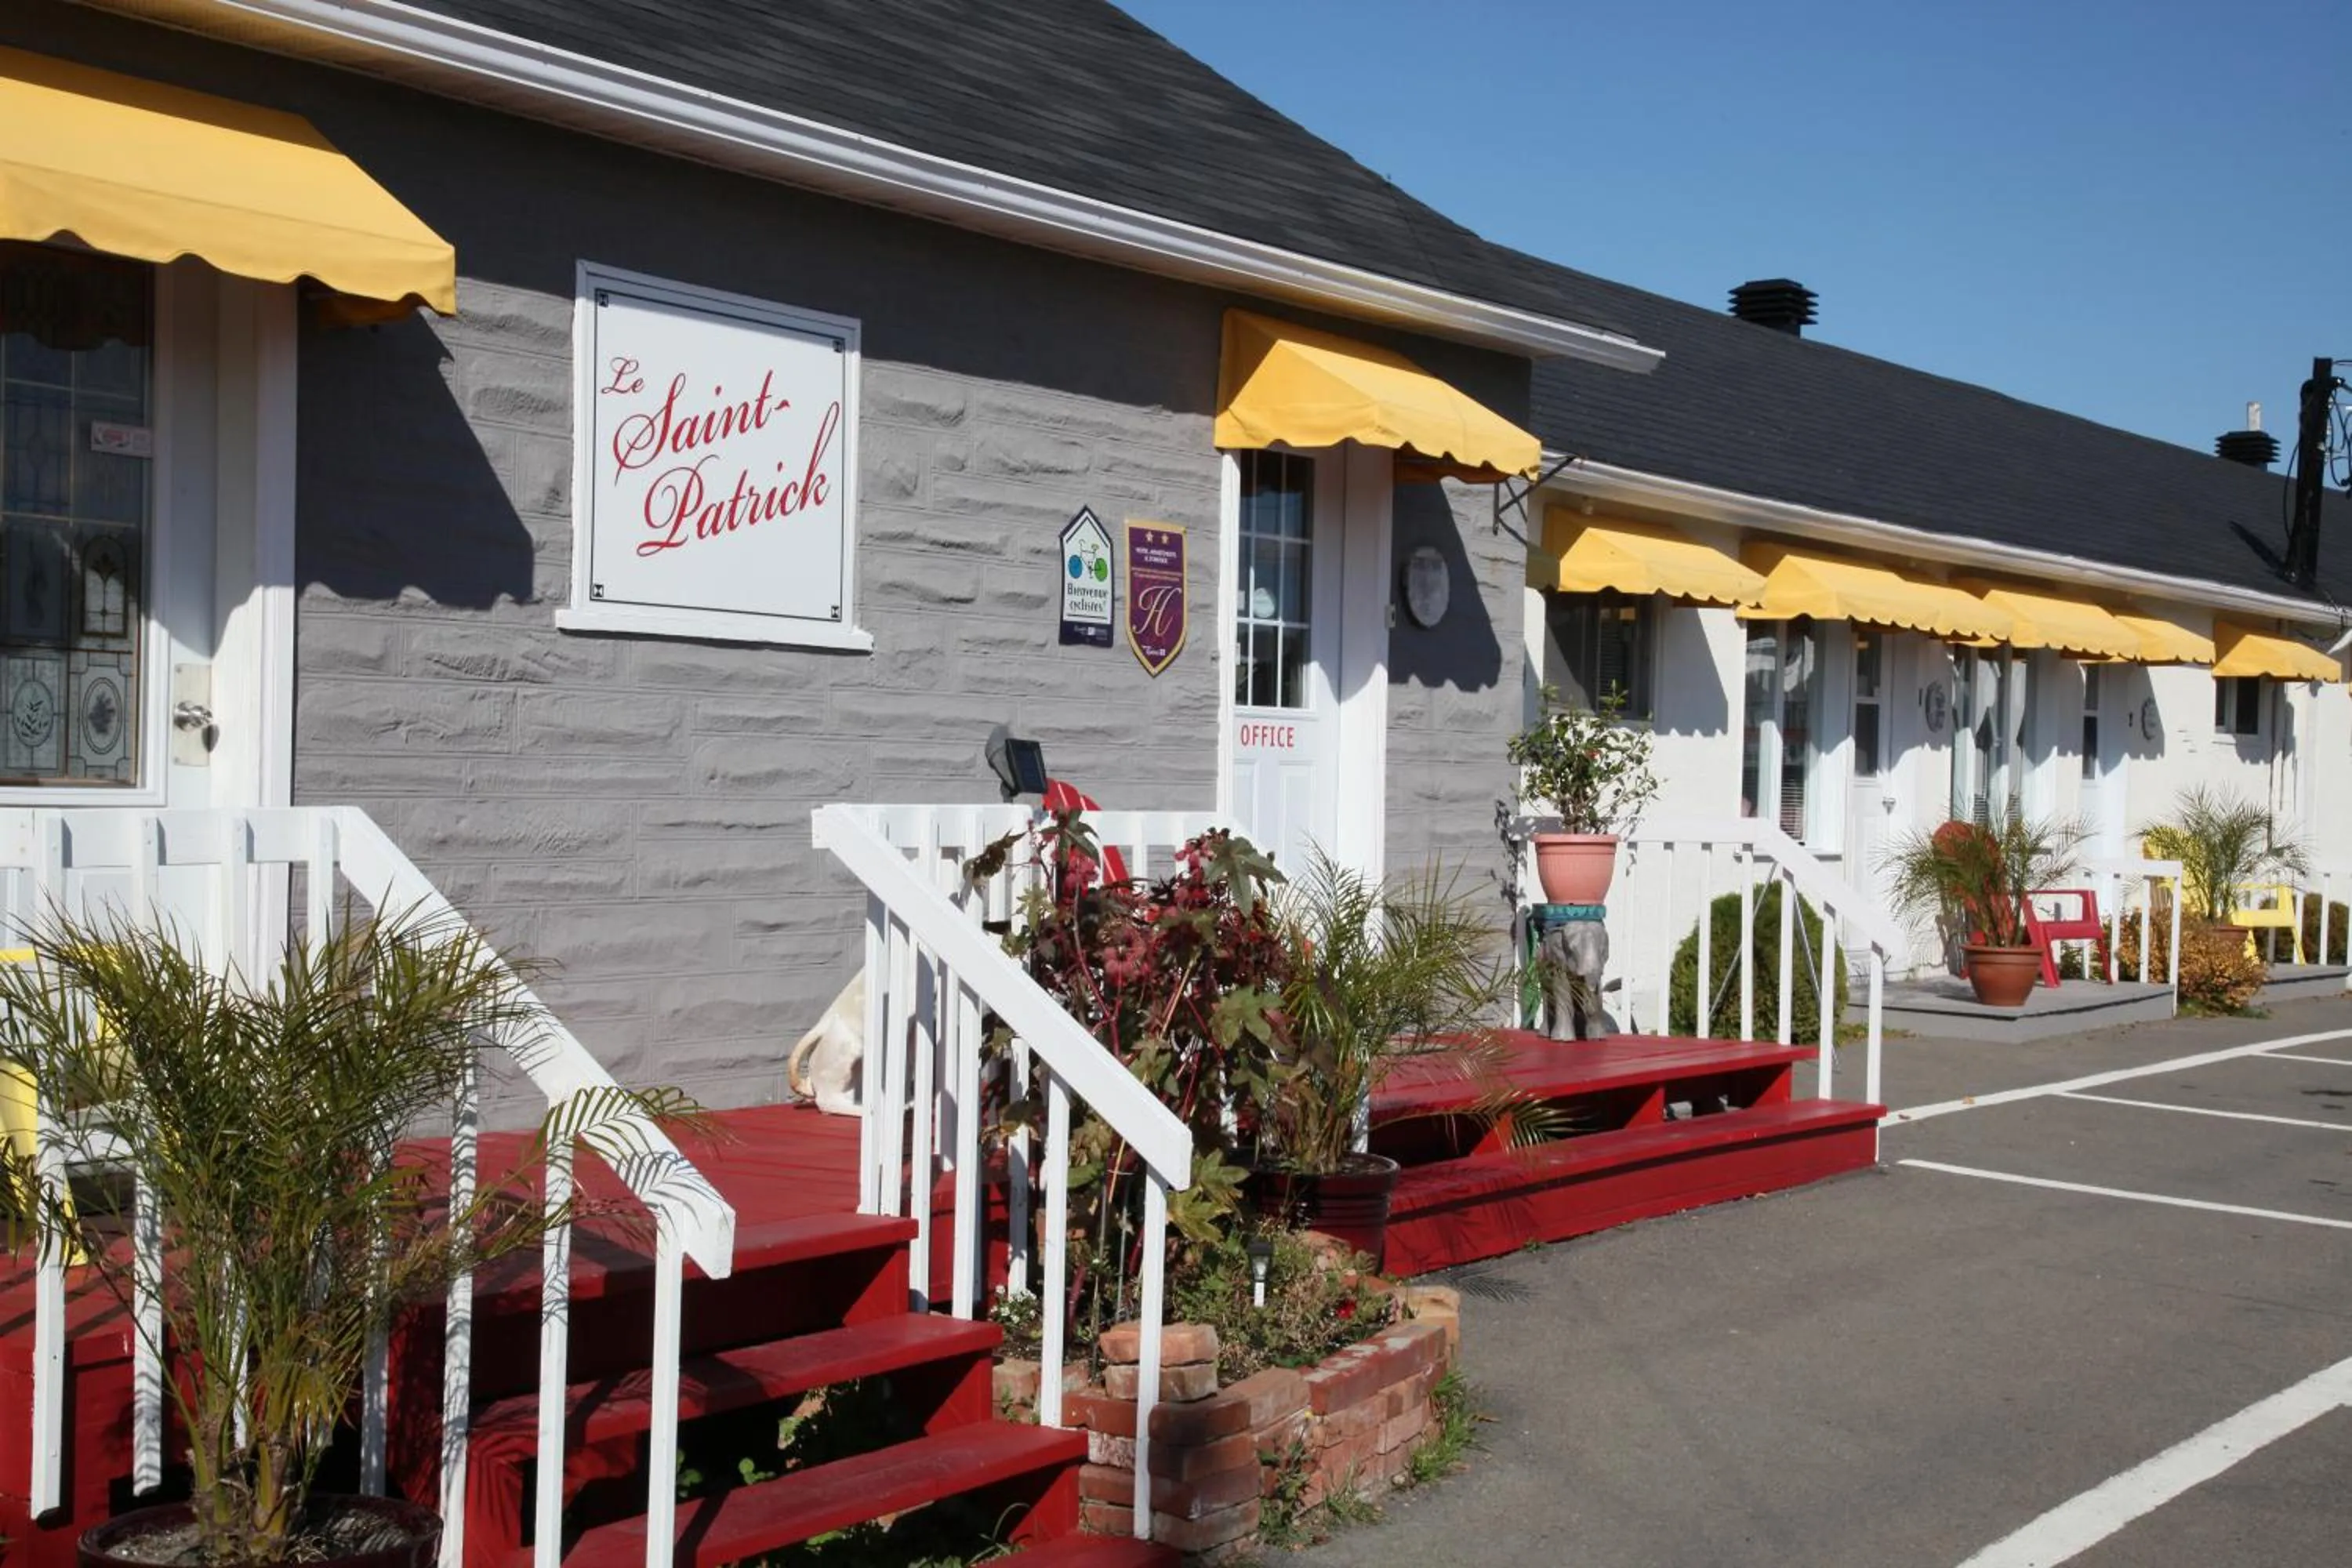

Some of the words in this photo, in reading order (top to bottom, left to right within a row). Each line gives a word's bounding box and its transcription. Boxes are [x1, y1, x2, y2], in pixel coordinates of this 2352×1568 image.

[601, 357, 644, 394] Le
[612, 369, 790, 487] Saint-
[636, 401, 840, 557] Patrick
[1241, 724, 1295, 747] OFFICE
